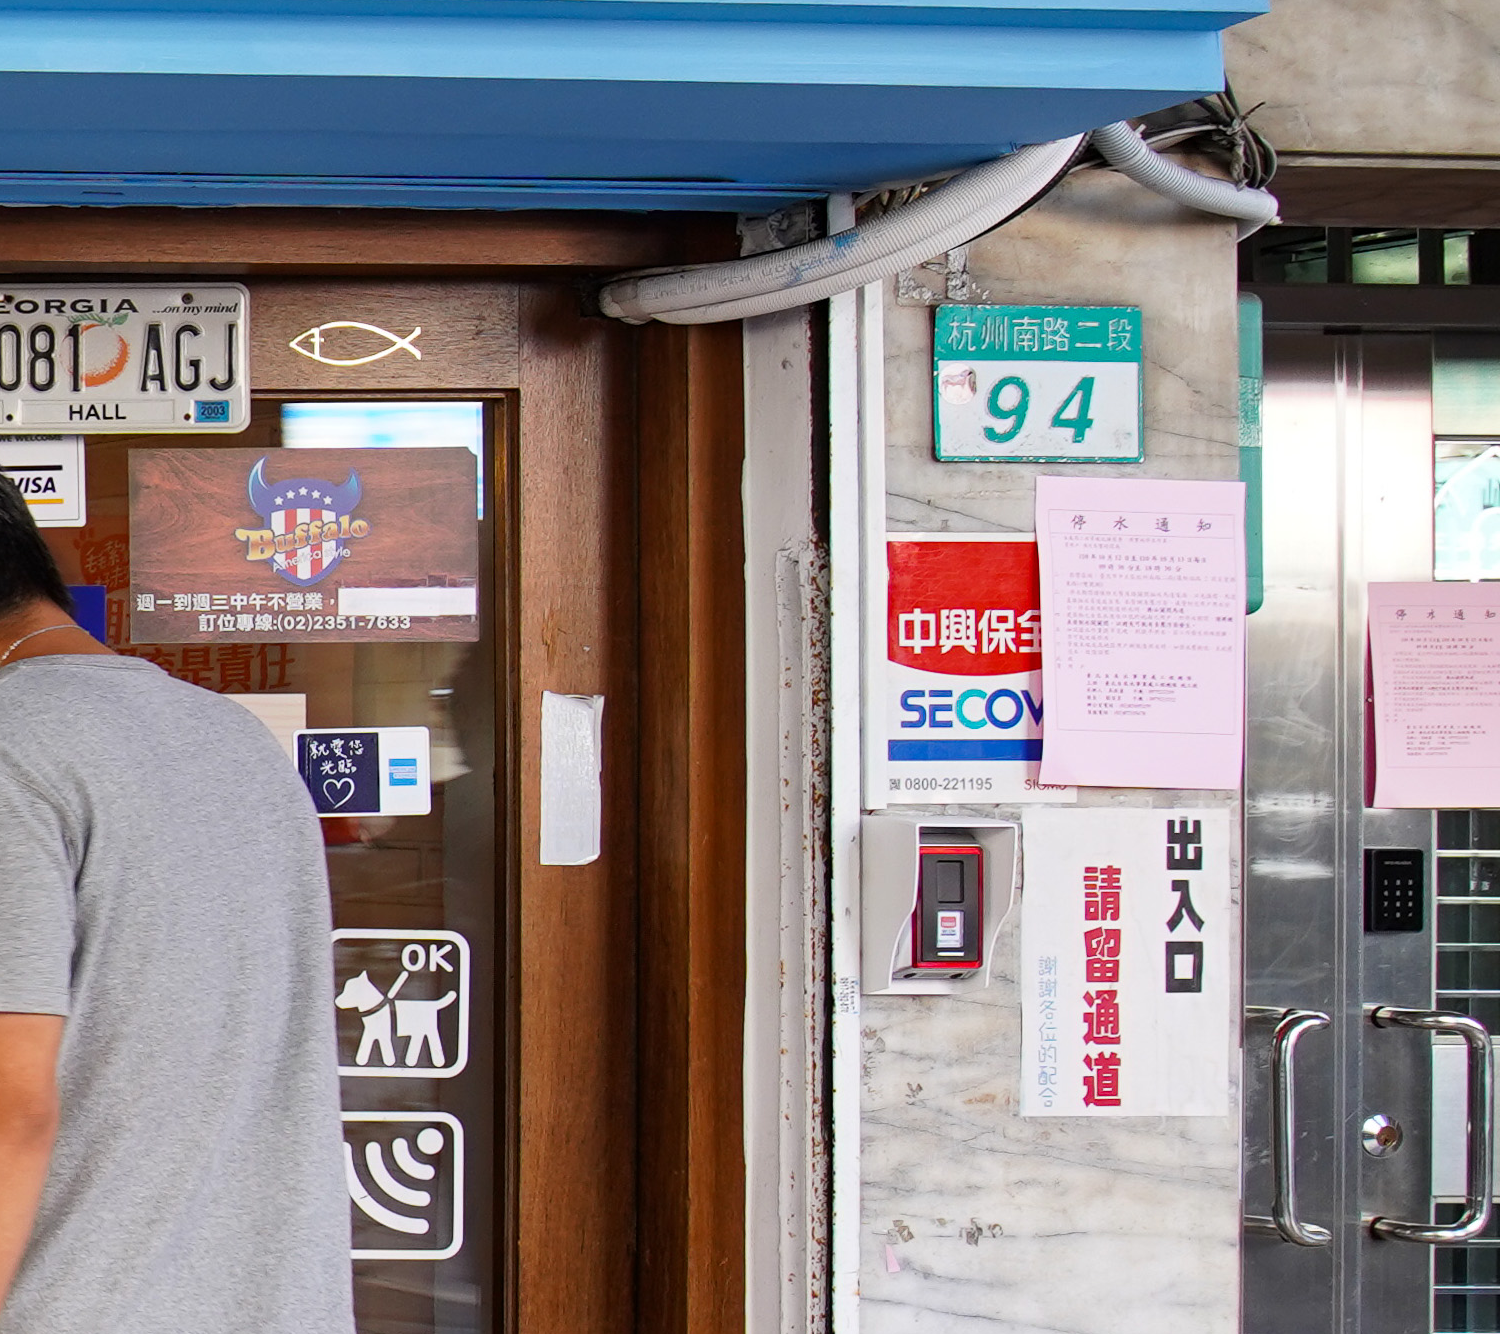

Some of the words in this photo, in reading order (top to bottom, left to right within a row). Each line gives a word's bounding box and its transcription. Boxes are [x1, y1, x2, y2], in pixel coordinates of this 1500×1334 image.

[182, 304, 202, 316] my
[203, 301, 239, 314] mind
[947, 316, 1135, 354] 杭州南路二段
[140, 322, 237, 392] AGJ
[68, 403, 128, 421] HALL
[200, 404, 226, 417] 2003
[982, 375, 1097, 445] 94
[235, 514, 370, 562] Buffalo
[1071, 514, 1212, 533] 停水通知
[904, 778, 994, 793] 0800-221195
[1165, 817, 1204, 994] 出入口
[400, 943, 454, 973] OK
[1082, 864, 1123, 1108] 請留通道
[1037, 955, 1059, 1108] 謝謝各位的配合
